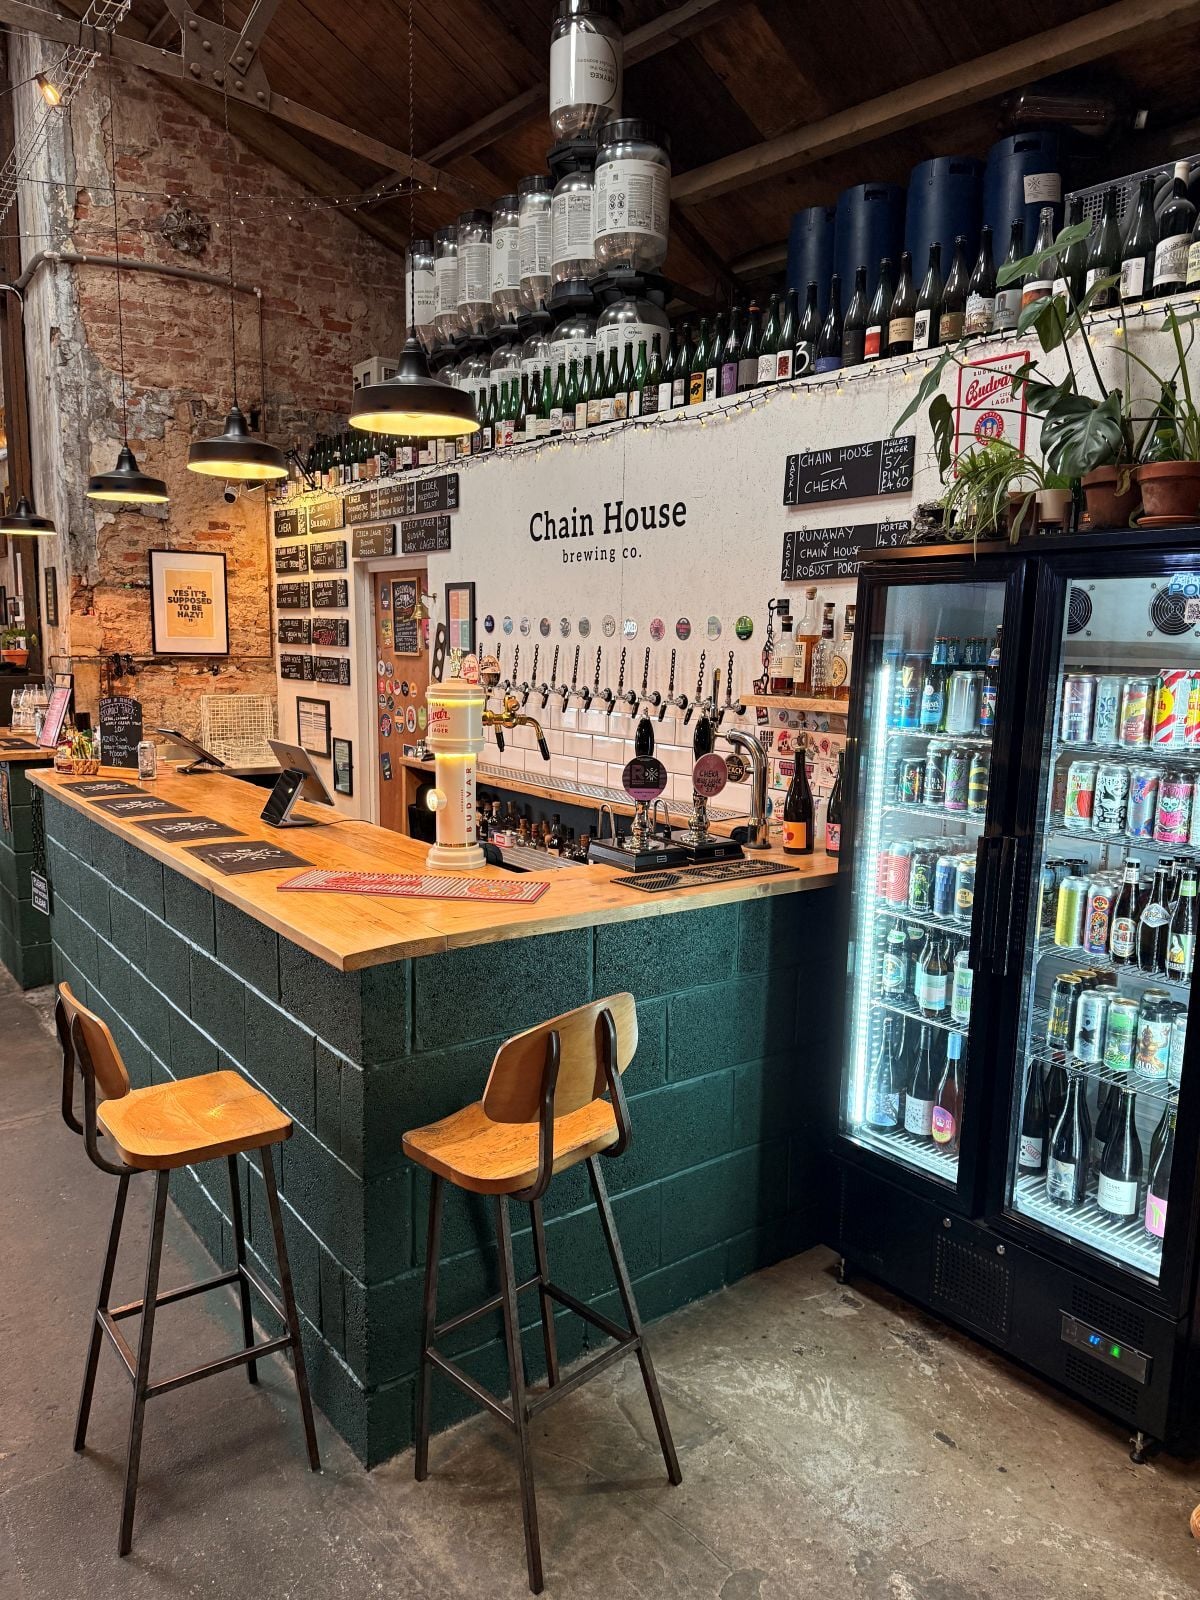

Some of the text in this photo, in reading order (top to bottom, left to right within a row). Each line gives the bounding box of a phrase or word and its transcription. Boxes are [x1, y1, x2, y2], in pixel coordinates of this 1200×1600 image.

[800, 443, 874, 468] CHAIN HOUSE
[884, 445, 909, 456] LAGER
[884, 455, 902, 470] 5%
[788, 456, 796, 488] CASK
[882, 465, 910, 481] PINT
[804, 475, 848, 494] CHEKA
[880, 477, 910, 493] £4.60
[785, 491, 795, 504] 1
[402, 520, 418, 531] CZECH
[420, 518, 436, 528] LAGER
[529, 500, 687, 542] Chain House
[880, 521, 909, 533] PORTER
[799, 526, 855, 544] RUNAWAY
[404, 542, 417, 552] DARK
[420, 538, 436, 550] LAGER
[785, 533, 793, 568] CASK
[562, 546, 642, 563] brewing co.
[800, 547, 828, 559] CHAIN
[782, 568, 791, 580] 2
[796, 563, 834, 577] ROBUST
[167, 596, 212, 605] SUPPOSED
[173, 589, 207, 598] YES IT'S
[177, 611, 204, 619] HAZY!
[191, 604, 203, 612] BE
